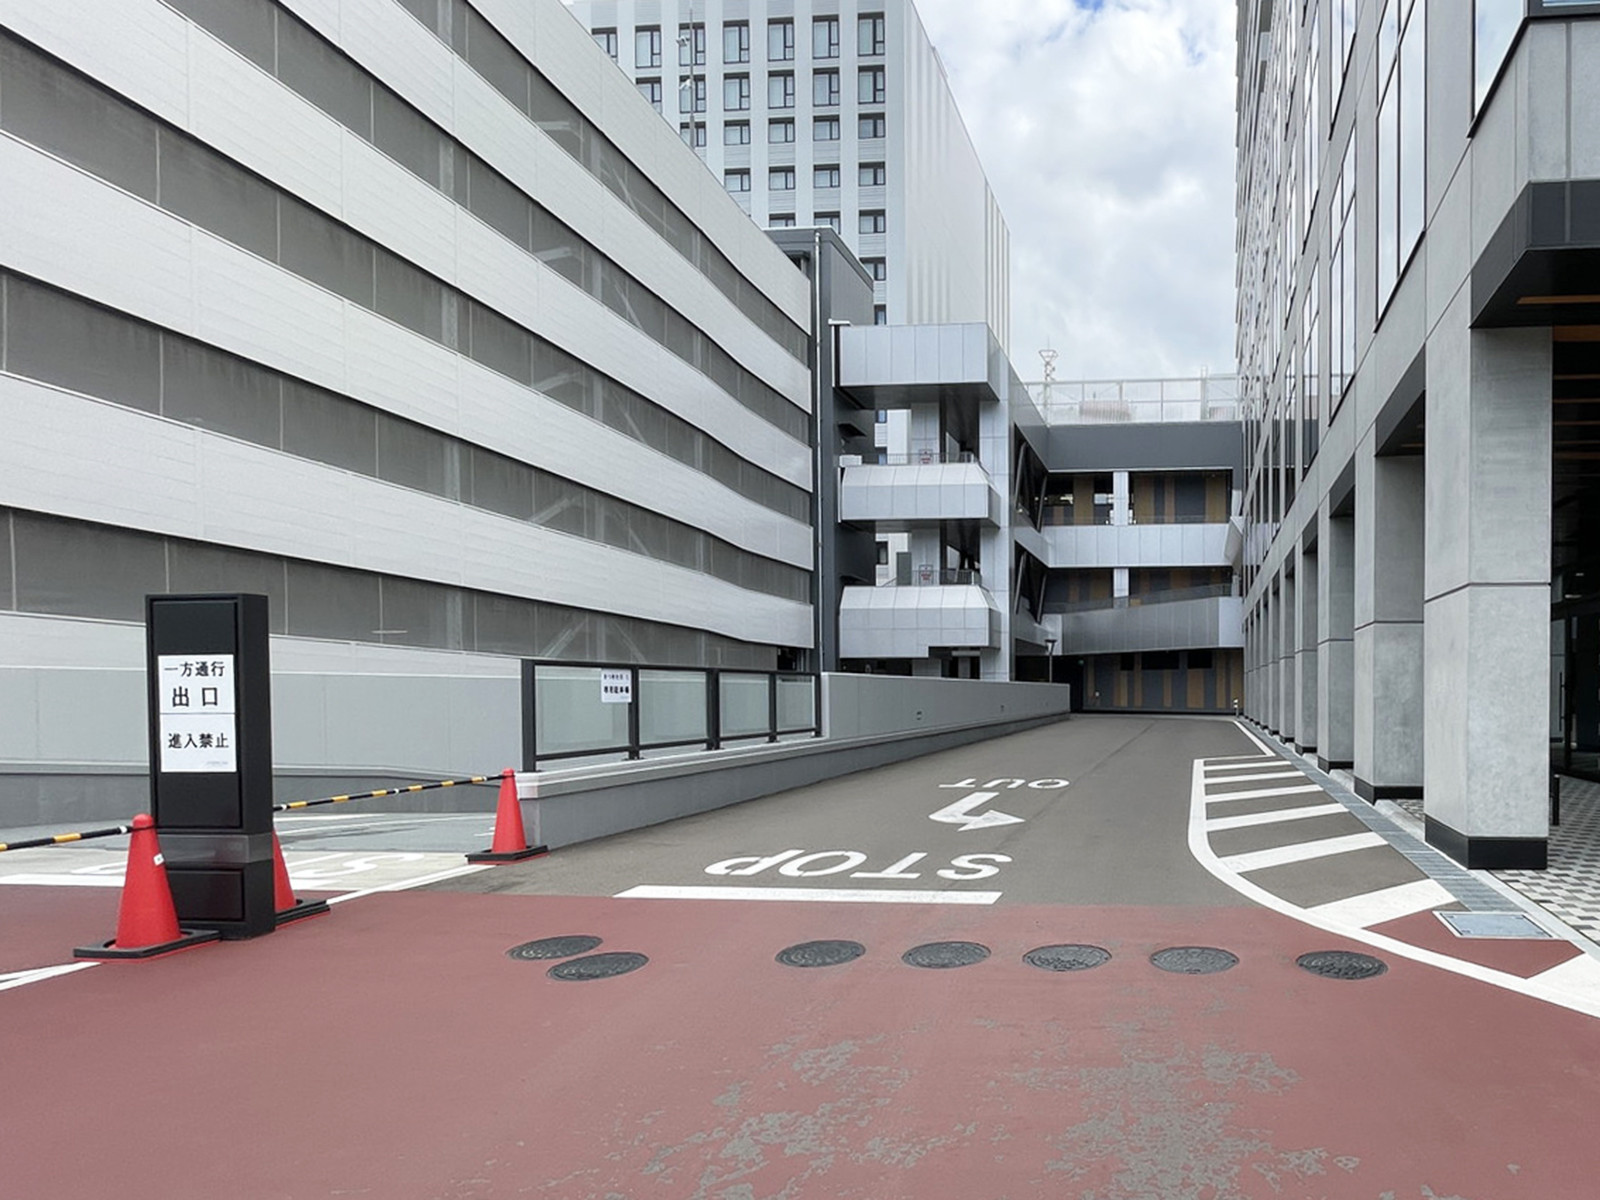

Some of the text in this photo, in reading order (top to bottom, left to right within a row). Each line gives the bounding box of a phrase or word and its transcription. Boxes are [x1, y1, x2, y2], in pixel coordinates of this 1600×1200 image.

[164, 660, 225, 677] 一方通行
[172, 686, 218, 707] 出口
[168, 733, 229, 748] 進入禁止
[938, 778, 1070, 789] OUT
[704, 849, 1013, 881] STOP
